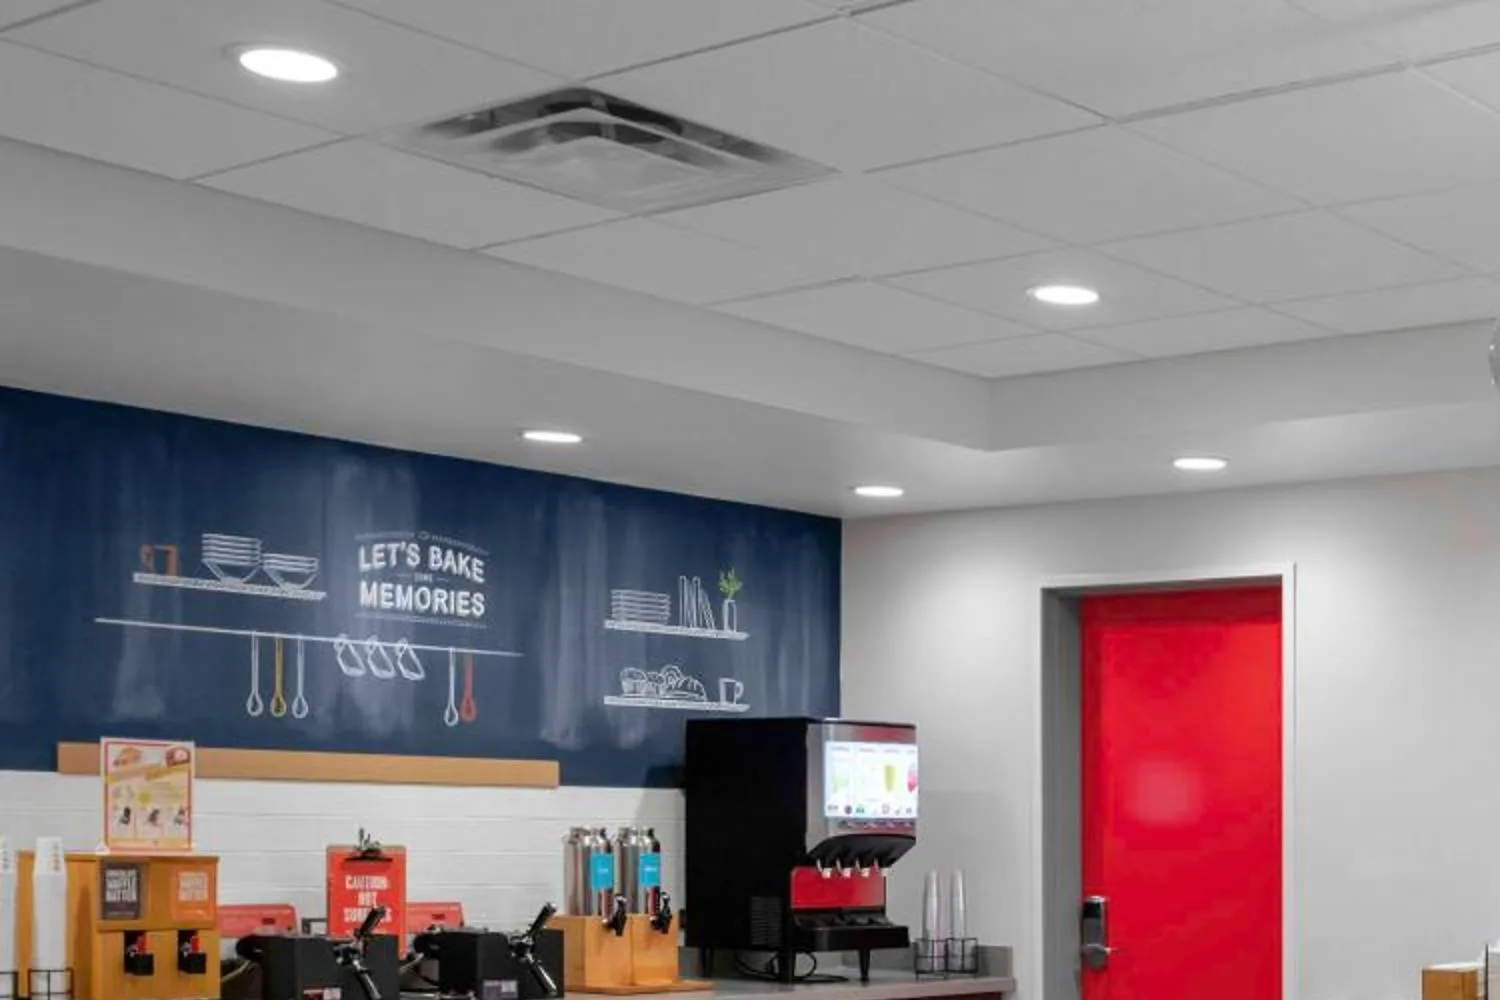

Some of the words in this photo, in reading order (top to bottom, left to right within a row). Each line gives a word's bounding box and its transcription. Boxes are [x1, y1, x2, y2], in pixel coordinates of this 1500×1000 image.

[359, 541, 421, 573] LET'S
[428, 544, 485, 583] BAKE
[359, 580, 486, 617] MEMORIES
